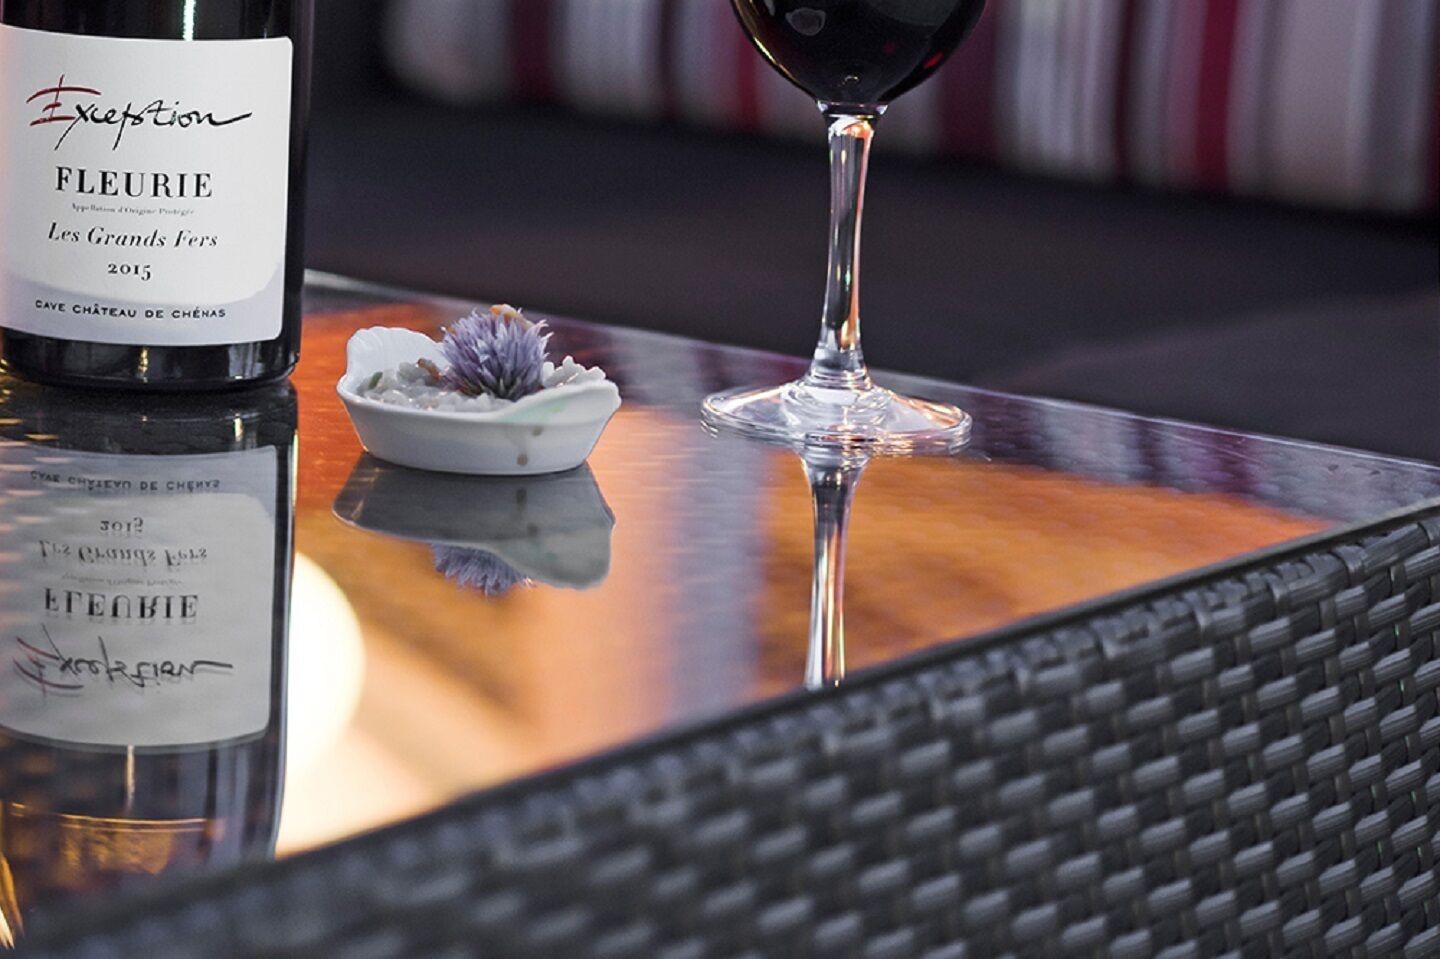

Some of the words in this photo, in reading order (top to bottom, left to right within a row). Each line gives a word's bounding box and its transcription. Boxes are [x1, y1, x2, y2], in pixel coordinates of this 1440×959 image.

[26, 74, 252, 151] Exception
[55, 166, 213, 198] FLEURIE
[72, 202, 115, 214] Appellation
[48, 222, 80, 242] Les
[88, 226, 166, 247] Grands
[174, 229, 218, 248] Fers
[108, 263, 151, 281] 2015
[35, 300, 66, 312] CAVE
[72, 303, 137, 318] CHÂTEAU
[145, 309, 164, 319] DE
[171, 307, 226, 319] CHÉNAS
